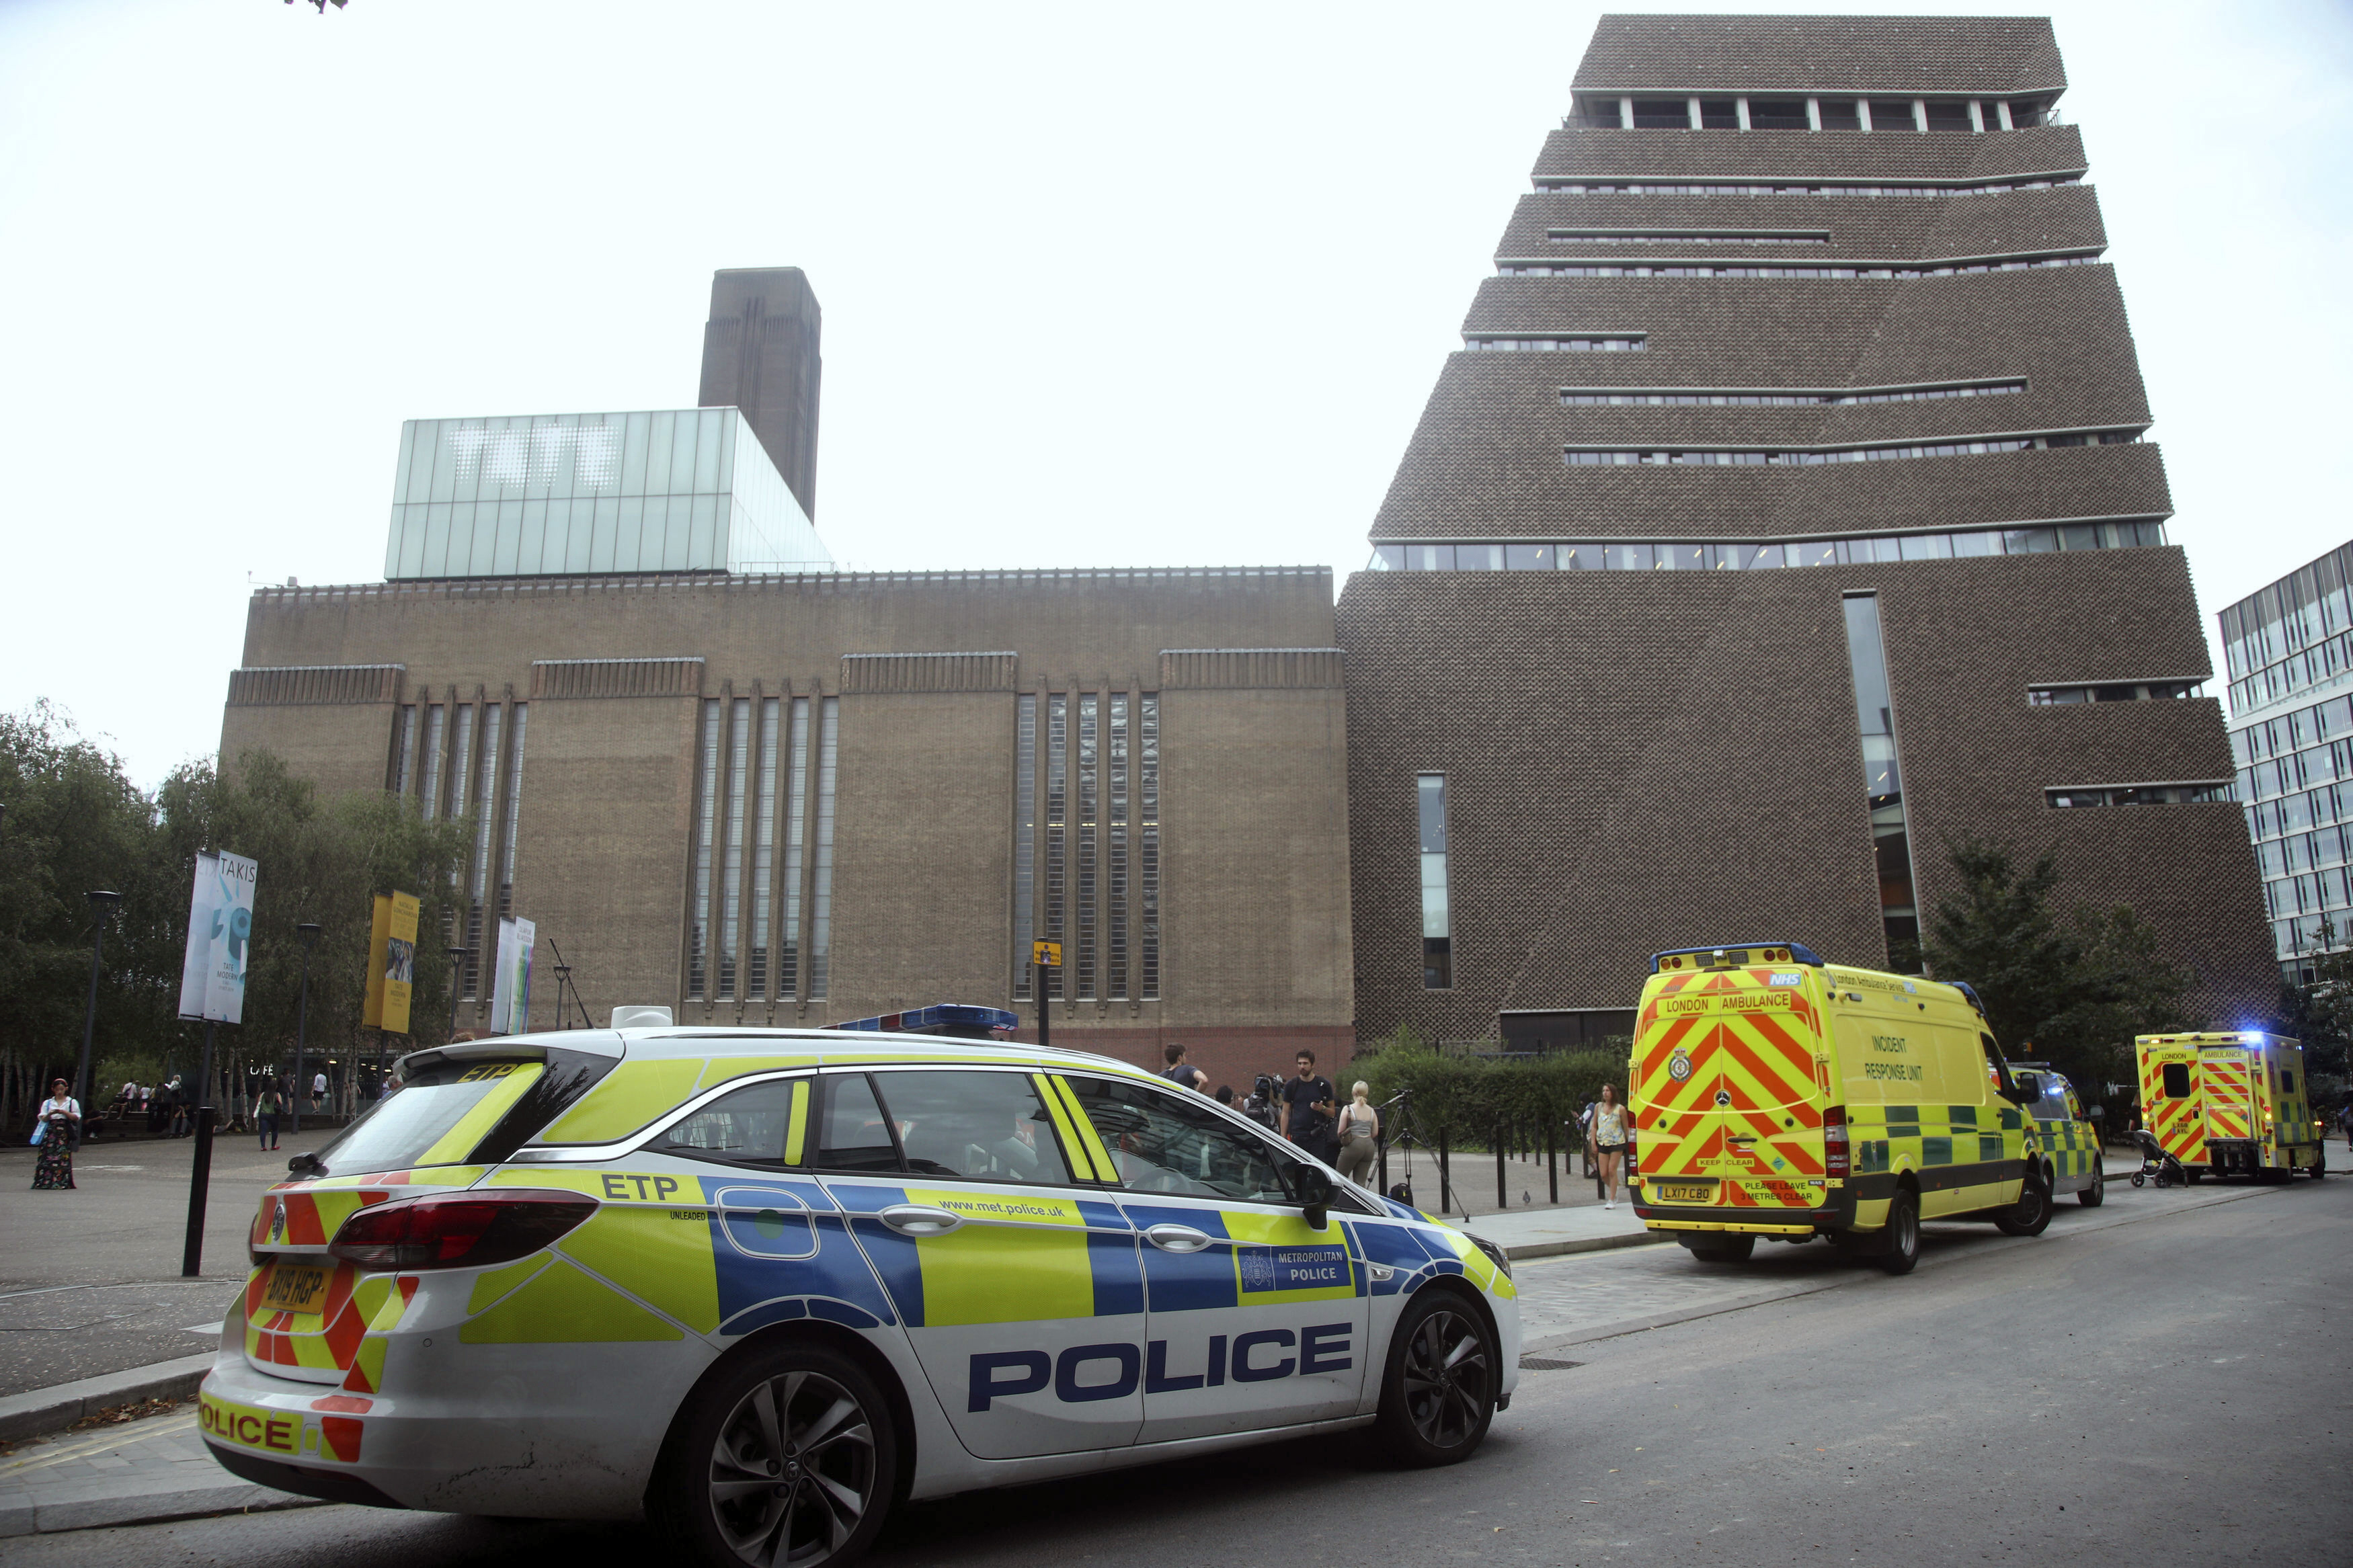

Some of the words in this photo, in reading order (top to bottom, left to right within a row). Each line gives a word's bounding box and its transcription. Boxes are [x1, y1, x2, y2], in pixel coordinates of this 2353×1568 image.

[221, 858, 255, 883] TAKIS
[216, 970, 238, 981] MODERN
[223, 962, 234, 972] TATE
[1769, 975, 1800, 985] NHS
[1833, 973, 1856, 985] London
[1856, 975, 1888, 991] Ambulance
[1667, 998, 1709, 1013] LONDON
[1722, 993, 1790, 1009] AMBULANCE
[1872, 1035, 1907, 1053] INCIDENT
[2204, 1050, 2243, 1059] AMBULANCE
[456, 1063, 519, 1083] ETP
[1864, 1063, 1907, 1080] RESPONSE
[1906, 1065, 1923, 1081] UNIT
[601, 1173, 678, 1200] ETP
[1665, 1188, 1687, 1198] LX17
[1745, 1182, 1778, 1190] PLEASE
[670, 1211, 706, 1221] UNLEADED
[938, 1200, 1066, 1217] www.met.police.uk
[1278, 1251, 1343, 1264] METROPOLITAN
[1290, 1267, 1337, 1281] POLICE
[290, 1270, 323, 1305] HGP
[967, 1322, 1353, 1413] POLICE
[200, 1402, 292, 1450] OLICE
